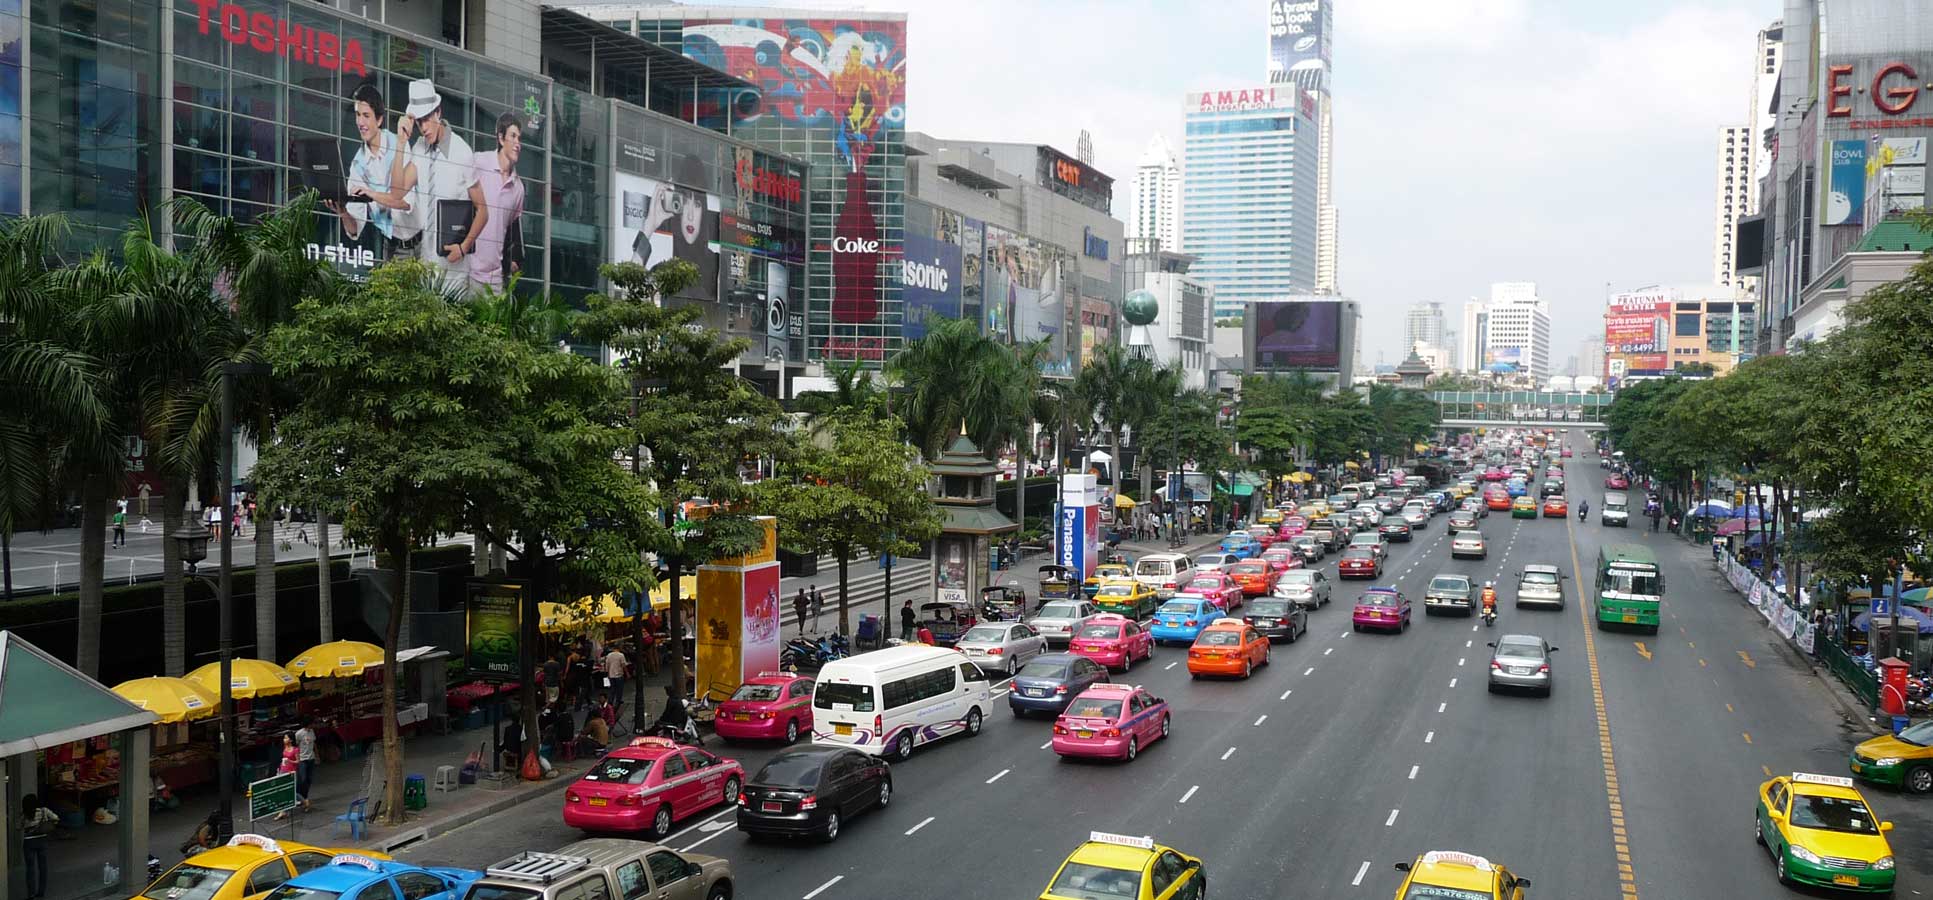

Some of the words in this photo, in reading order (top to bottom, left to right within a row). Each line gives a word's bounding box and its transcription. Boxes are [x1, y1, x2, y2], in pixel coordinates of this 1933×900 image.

[1271, 2, 1282, 14] A
[1283, 0, 1319, 12] brand
[1271, 14, 1285, 25] to
[1286, 11, 1313, 24] look
[191, 0, 367, 77] TOSHIBA
[1271, 25, 1288, 37] up
[1200, 87, 1276, 106] AMARI
[1833, 150, 1864, 160] BOWL
[736, 159, 801, 203] Canon
[832, 236, 879, 254] Coke
[324, 242, 375, 269] style
[1617, 296, 1664, 304] PRATUNAM
